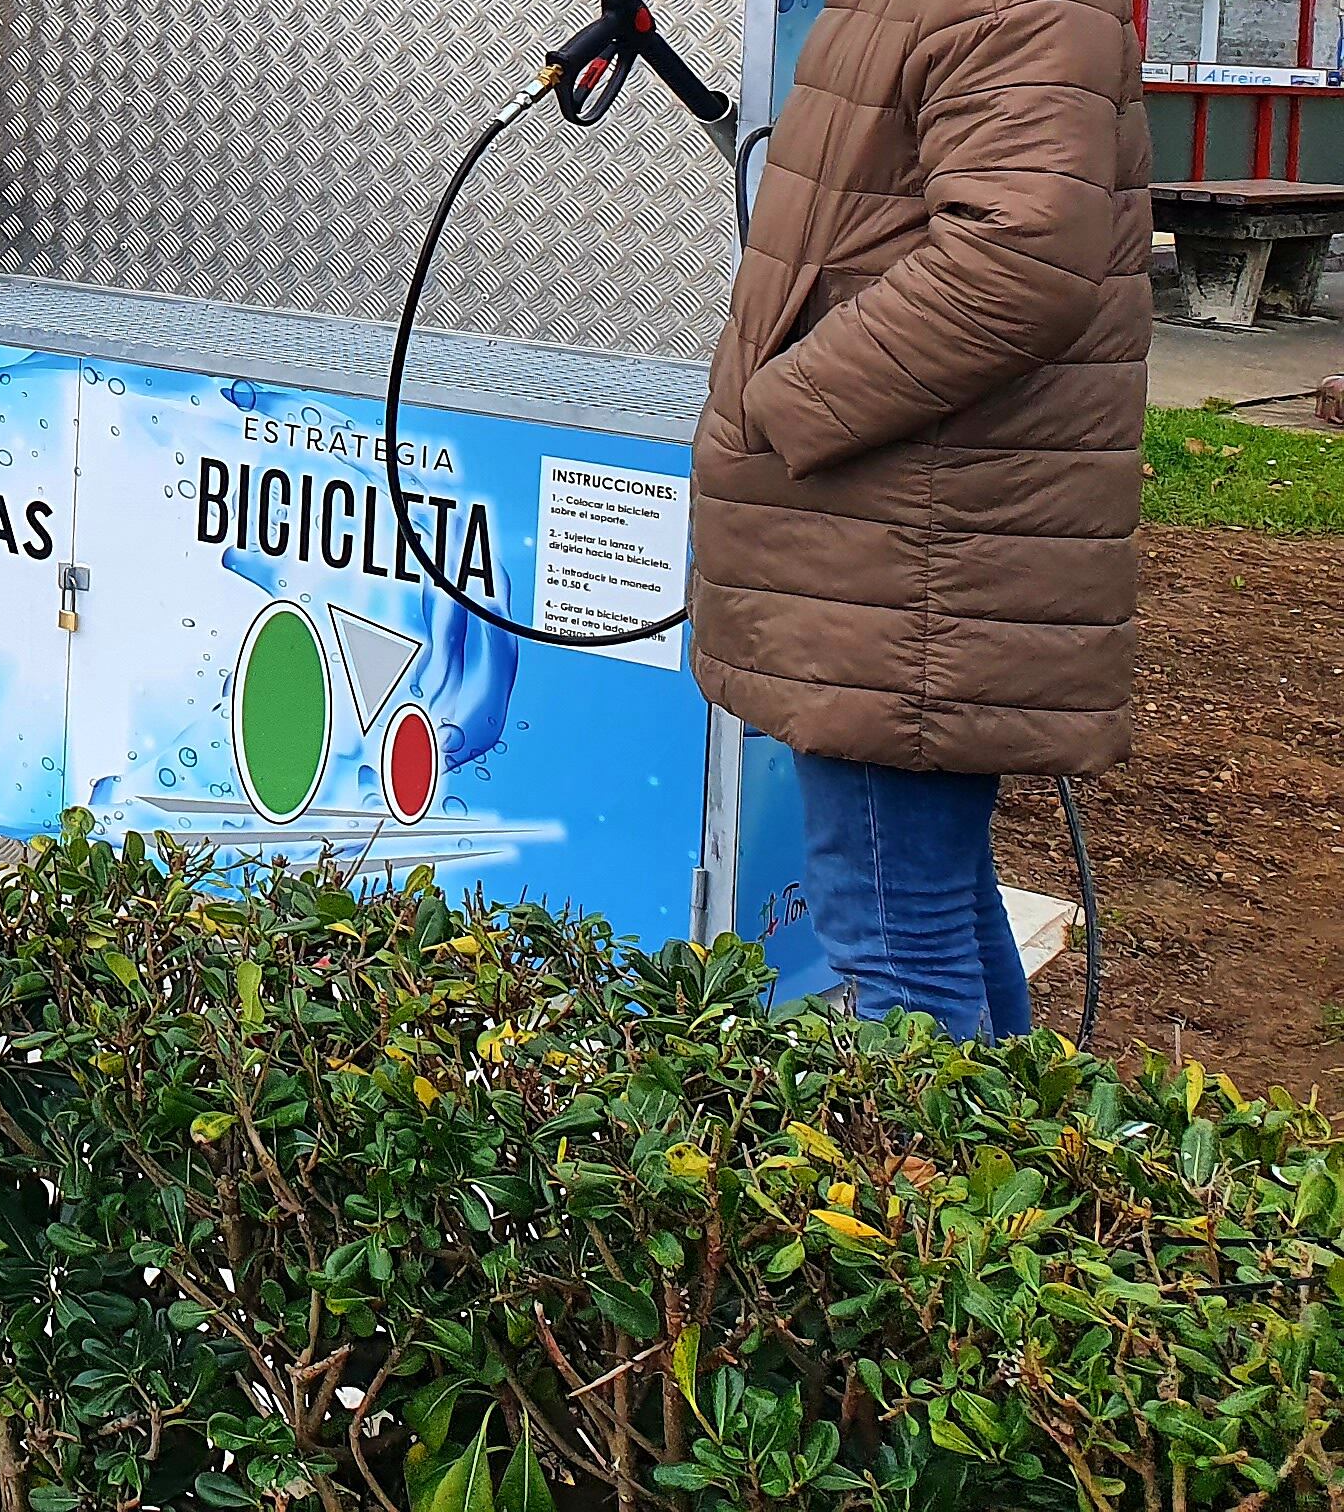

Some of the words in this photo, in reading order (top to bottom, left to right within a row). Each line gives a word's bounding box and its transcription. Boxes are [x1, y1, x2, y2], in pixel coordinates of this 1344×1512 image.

[1221, 69, 1272, 85] Freire
[244, 417, 454, 473] ESTRATEGIA
[552, 469, 677, 501] INSTRUCCIONES:
[551, 507, 576, 517] sobre
[579, 511, 587, 519] el
[590, 514, 628, 526] soporte.
[566, 496, 603, 509] Colocar
[606, 503, 615, 511] la
[618, 504, 660, 519] bicicleta
[197, 457, 495, 598] BICICLETA
[564, 532, 596, 544] Sujetar
[598, 537, 607, 546] la
[610, 539, 636, 551] lanza
[638, 545, 644, 554] y
[549, 541, 583, 553] dirigirla
[586, 547, 612, 559] hacia
[615, 553, 624, 561] la
[627, 554, 672, 570] bicicleta.
[547, 577, 559, 585] de
[562, 567, 606, 582] Introducir
[609, 575, 617, 584] la
[621, 579, 661, 592] moneda
[545, 612, 568, 623] lavar
[571, 615, 579, 625] el
[582, 619, 600, 629] otro
[561, 603, 583, 613] Girar
[586, 607, 594, 616] la
[597, 609, 638, 625] bicicleta
[545, 623, 556, 632] los
